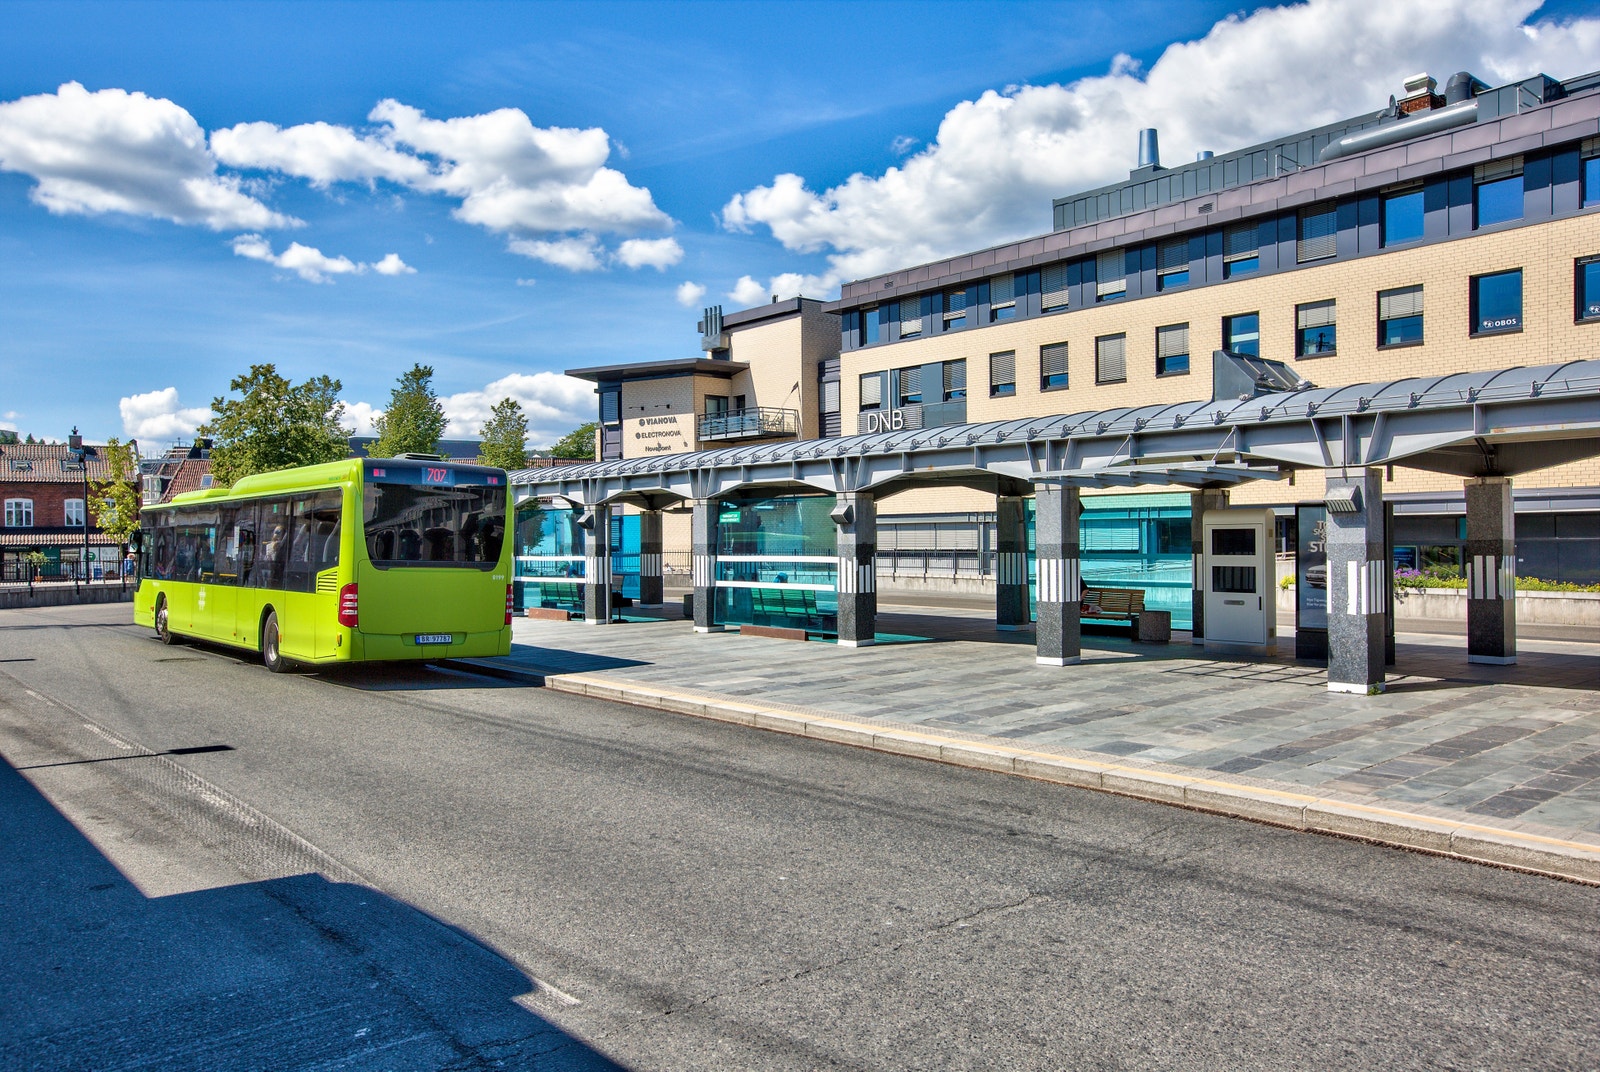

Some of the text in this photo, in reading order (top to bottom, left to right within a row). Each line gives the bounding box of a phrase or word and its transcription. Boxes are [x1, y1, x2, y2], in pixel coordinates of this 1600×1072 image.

[1495, 318, 1516, 327] OBOS
[646, 416, 677, 426] VIANOVA
[867, 410, 903, 433] DNB
[641, 430, 681, 439] ELECTRONOVA
[427, 467, 447, 482] 707
